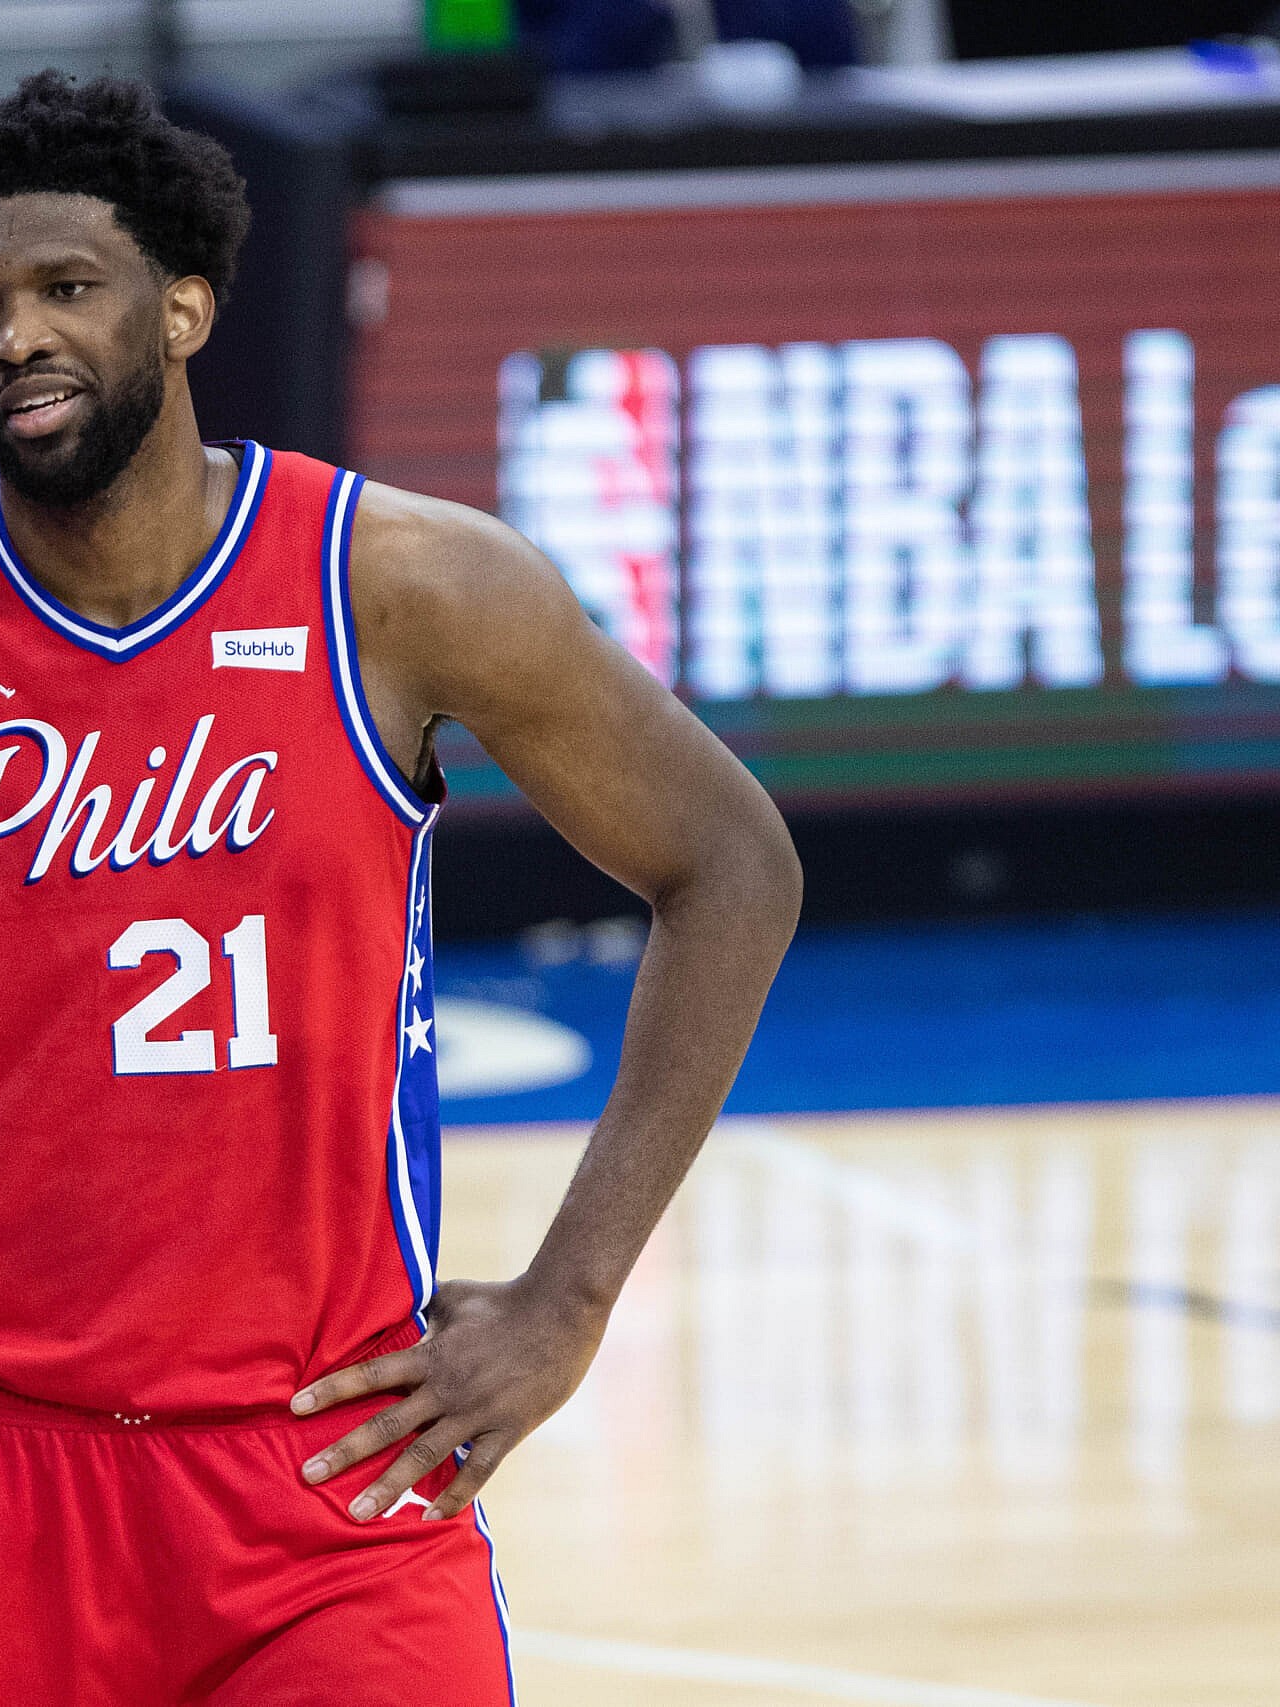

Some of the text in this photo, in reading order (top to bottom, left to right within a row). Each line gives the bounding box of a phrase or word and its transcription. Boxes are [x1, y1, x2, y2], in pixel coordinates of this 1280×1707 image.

[688, 332, 1106, 701] NBA
[224, 640, 295, 657] StubHub
[107, 913, 278, 1075] 21
